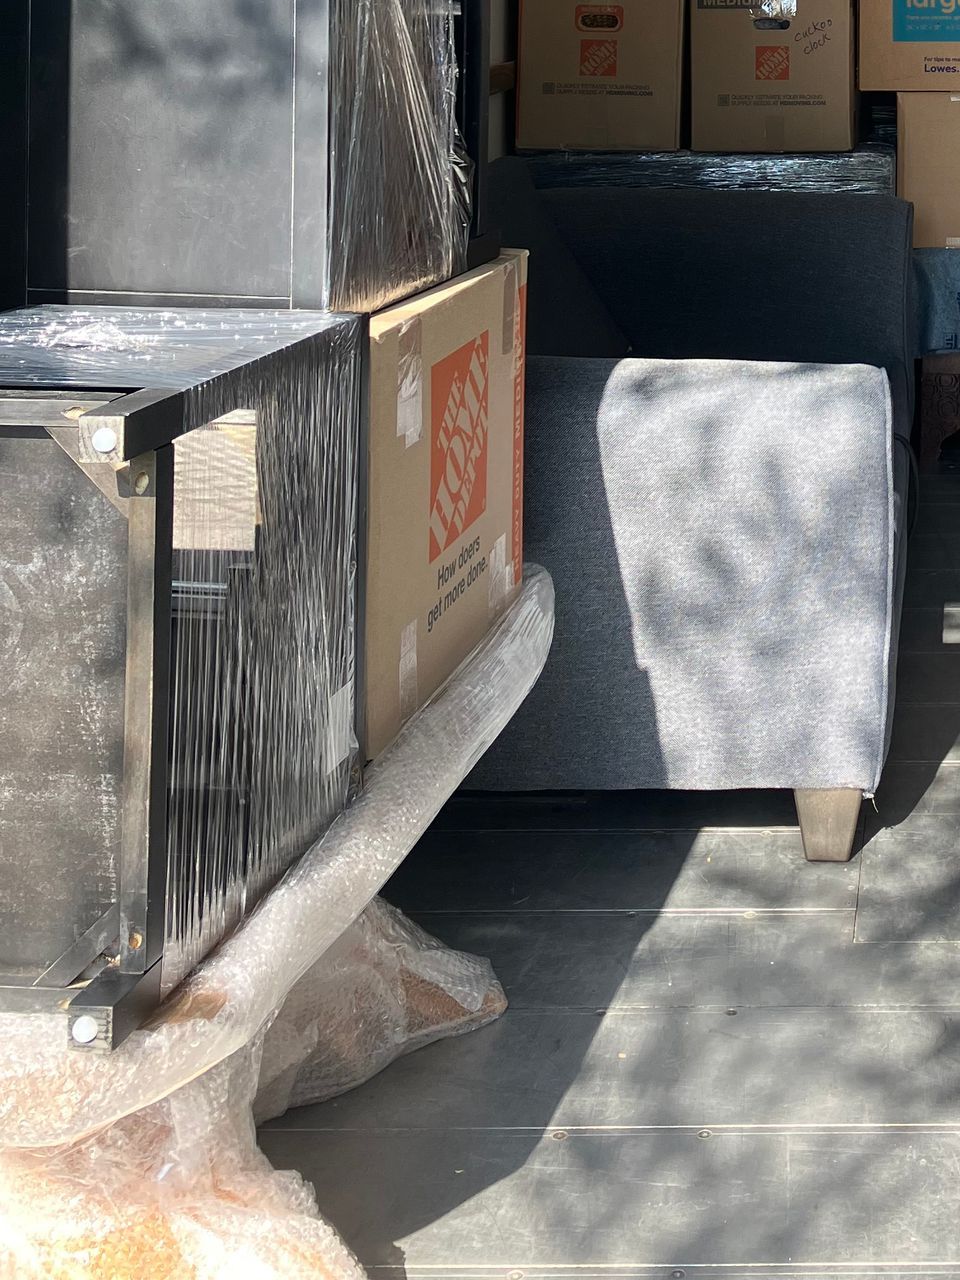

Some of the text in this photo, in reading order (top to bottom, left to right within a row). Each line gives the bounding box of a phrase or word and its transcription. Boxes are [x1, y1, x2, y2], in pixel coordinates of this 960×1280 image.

[430, 336, 488, 552] HOME
[437, 371, 463, 453] THE
[453, 402, 488, 534] DEPOT
[437, 536, 480, 590] How doers
[427, 597, 442, 633] get
[444, 578, 465, 612] more
